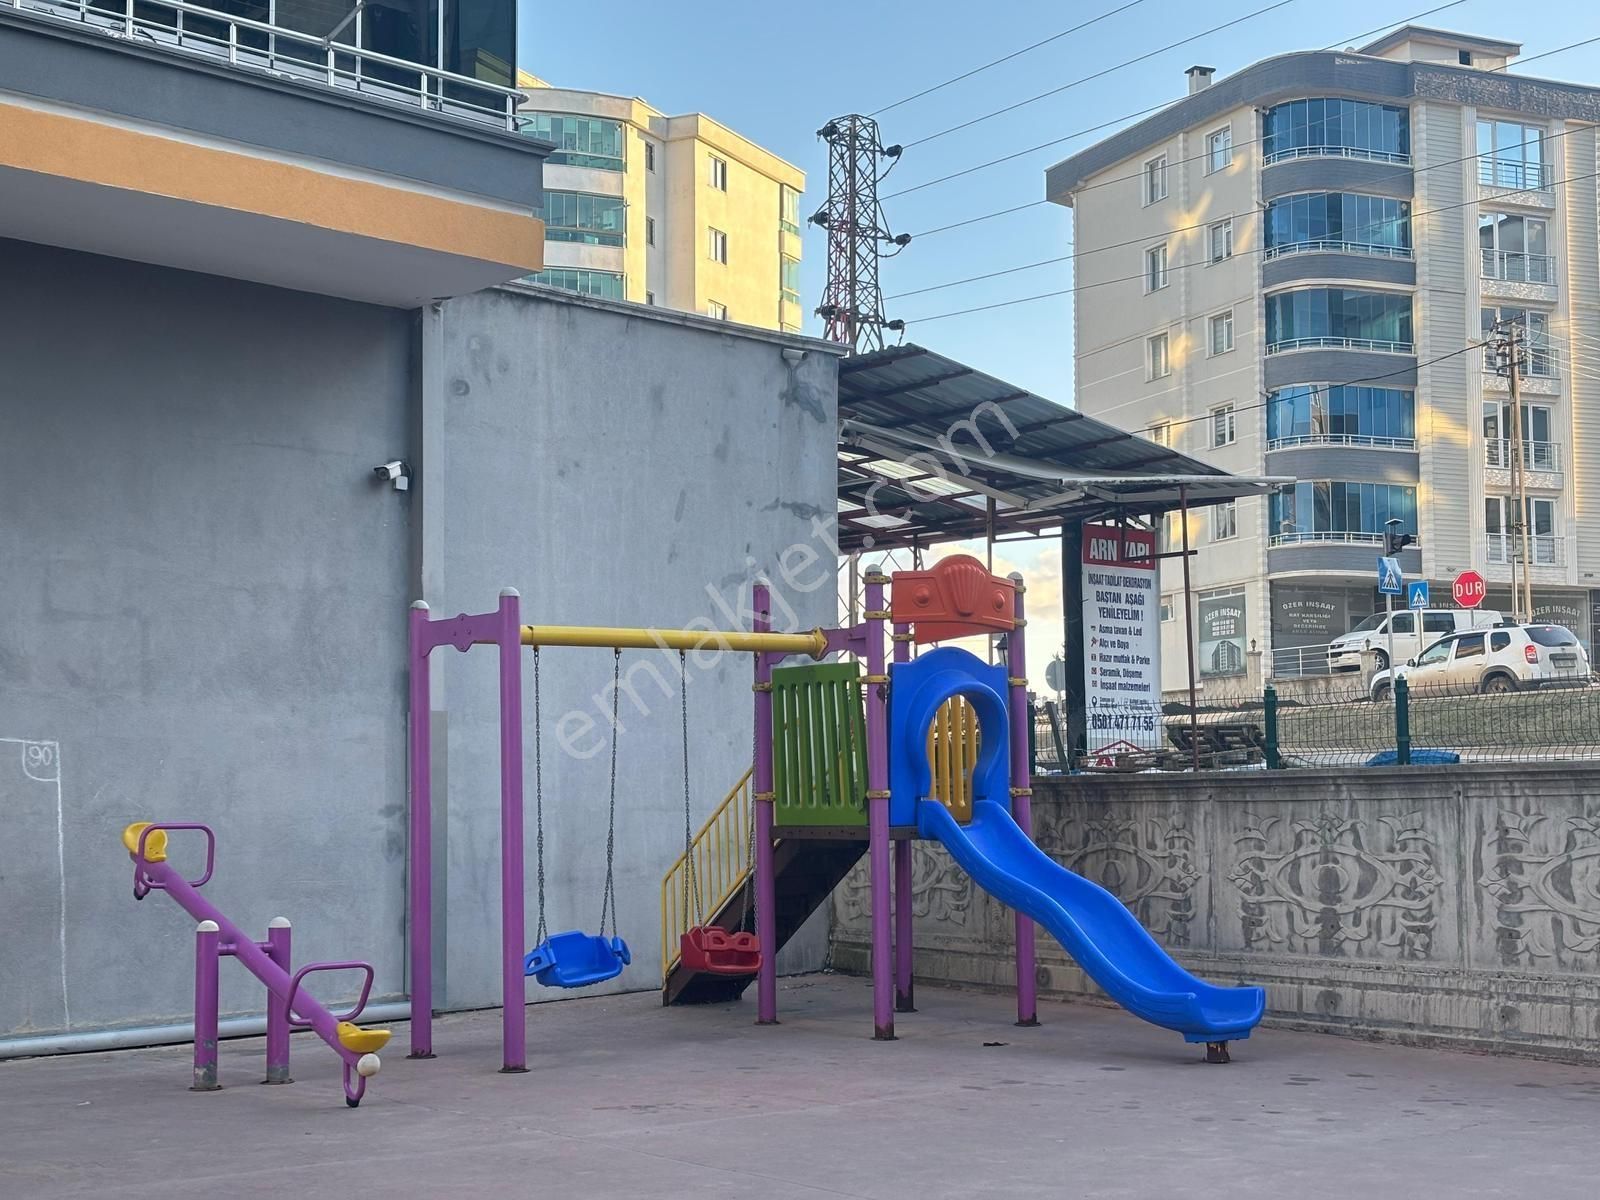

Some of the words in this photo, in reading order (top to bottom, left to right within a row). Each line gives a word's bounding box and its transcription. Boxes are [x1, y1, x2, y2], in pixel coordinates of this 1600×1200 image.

[1089, 537, 1117, 561] ARN
[1455, 581, 1483, 598] DUR
[1096, 590, 1122, 604] BAŞTAN
[1125, 592, 1145, 606] AŞAĞI
[1099, 624, 1113, 634] Asma
[1114, 625, 1128, 636] tavan
[1133, 626, 1142, 636] Led
[1110, 640, 1116, 648] ve
[1117, 639, 1129, 649] Boya
[1136, 656, 1151, 665] Parke
[1118, 682, 1151, 692] malzemeleri
[1114, 714, 1129, 731] 471
[1132, 715, 1141, 731] 71
[1143, 716, 1154, 731] 55
